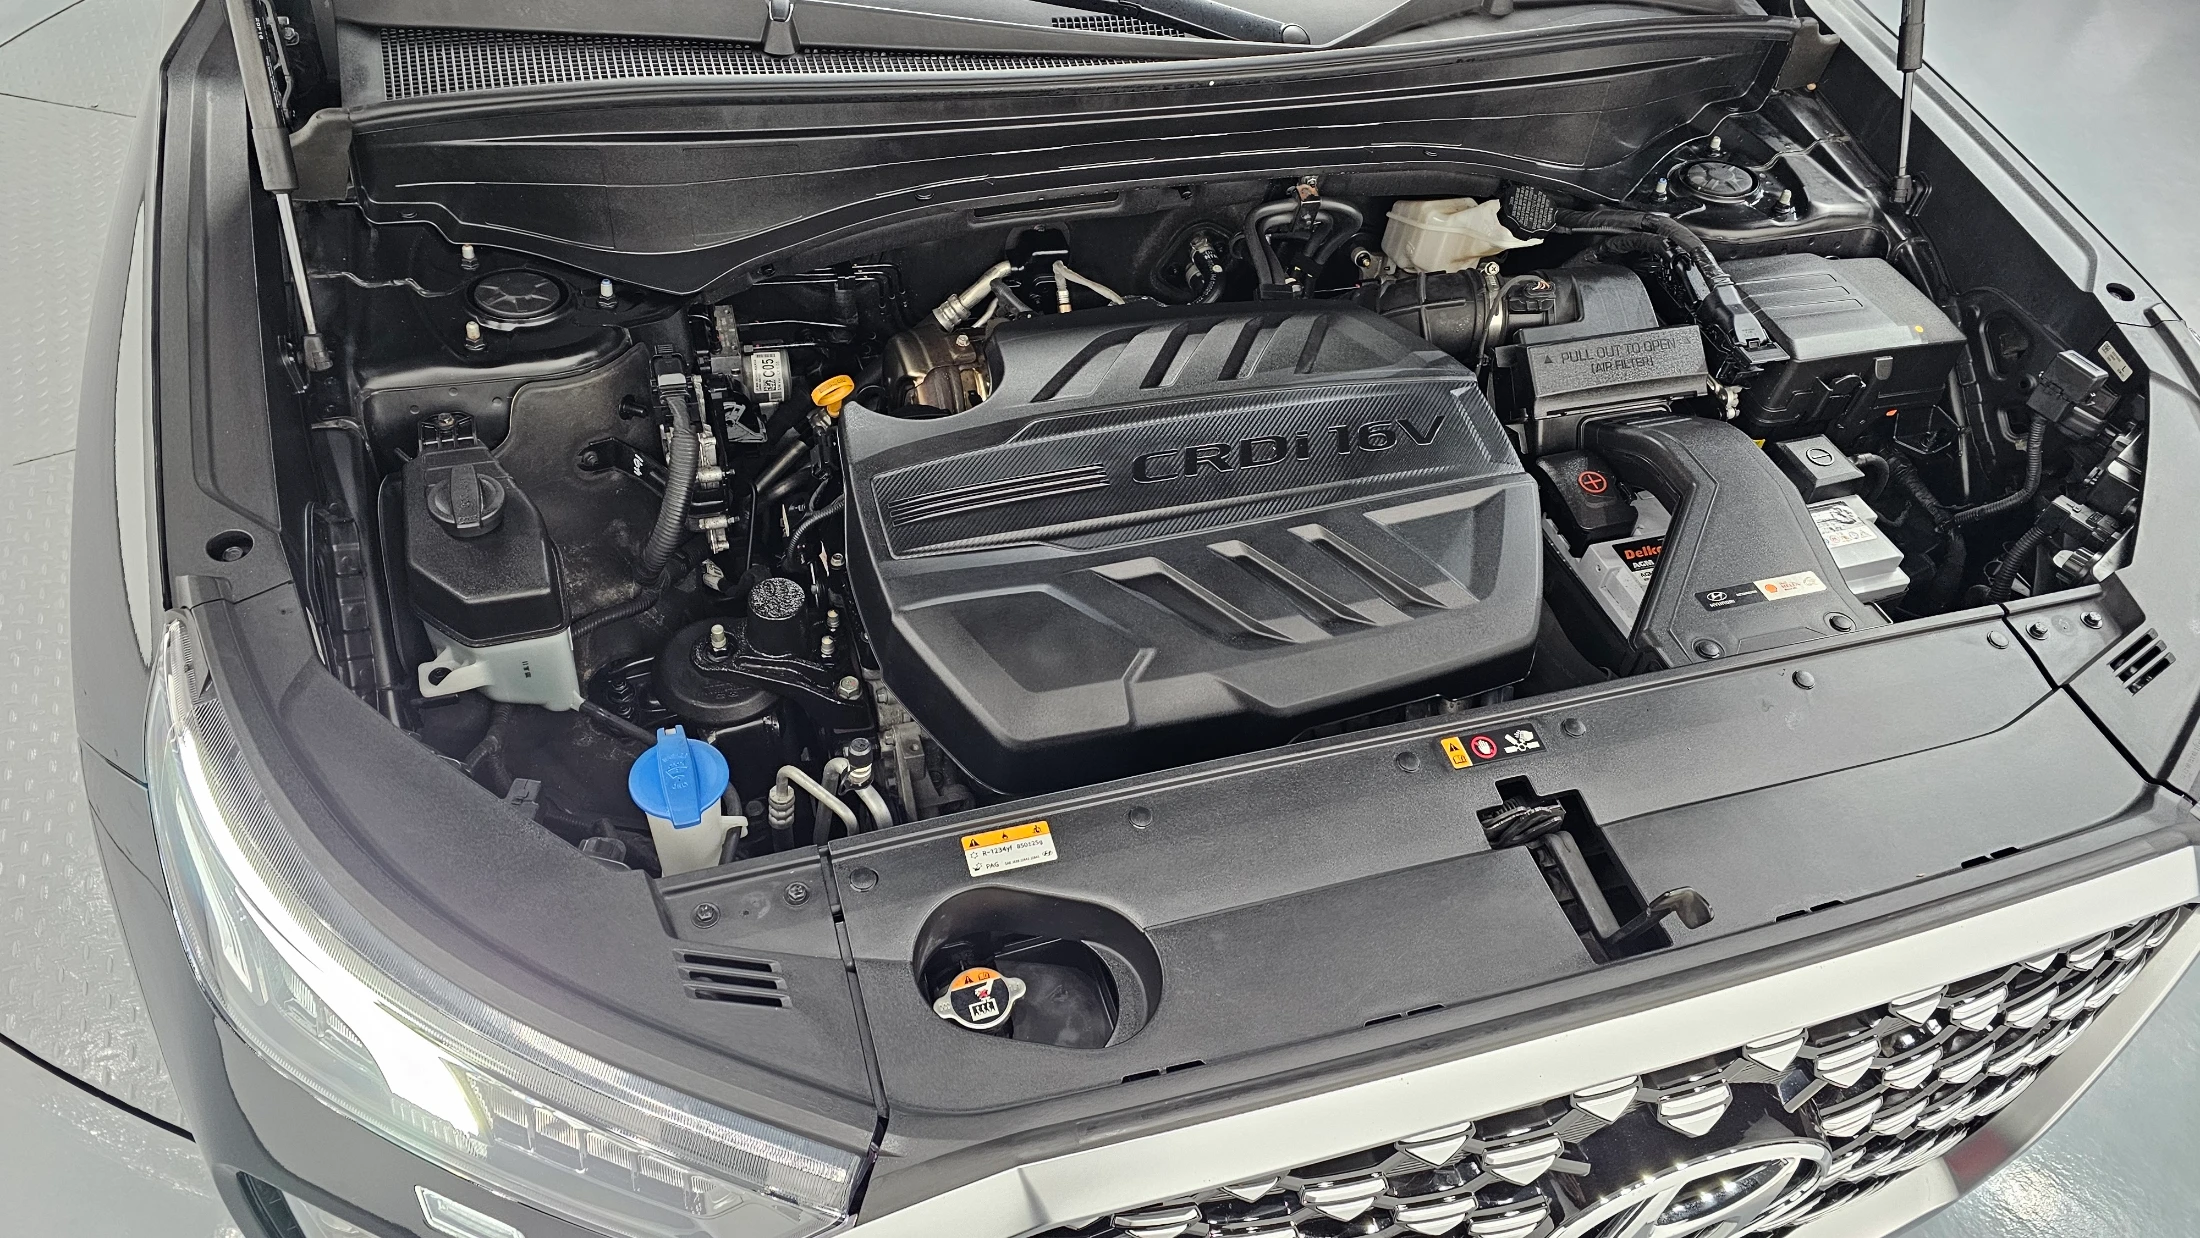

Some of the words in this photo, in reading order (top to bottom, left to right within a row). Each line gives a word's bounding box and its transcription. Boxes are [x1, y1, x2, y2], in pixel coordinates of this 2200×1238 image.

[1561, 350, 1593, 364] PULL
[1597, 344, 1621, 358] OUT
[1626, 342, 1641, 355] TO
[1643, 337, 1676, 352] OPEN
[762, 358, 775, 378] C05
[1132, 431, 1309, 484] CRDi
[1328, 415, 1445, 455] 16V
[1632, 559, 1655, 569] AGM
[982, 844, 1013, 857] R-1234yf
[985, 861, 1000, 870] PAG
